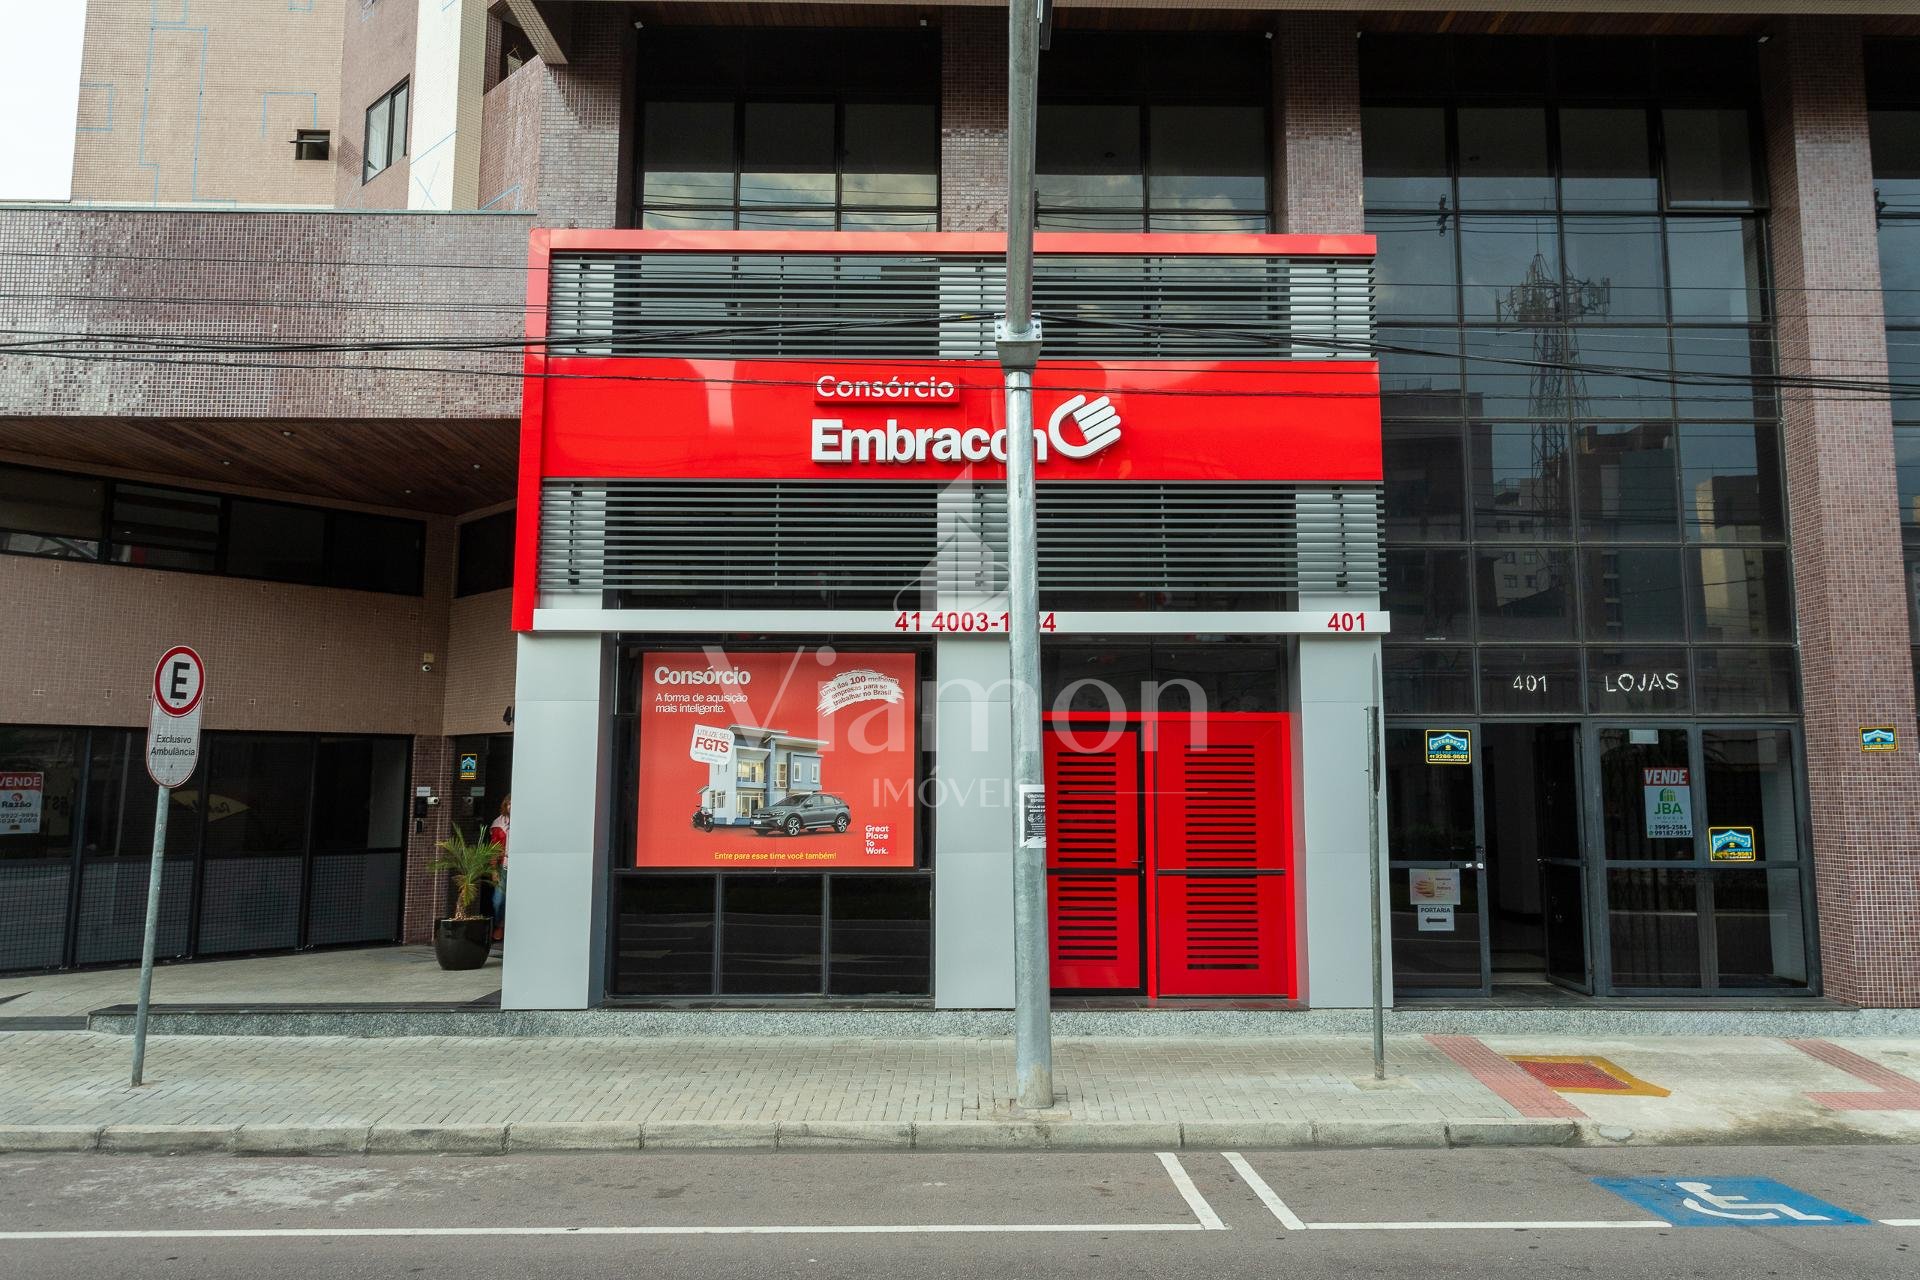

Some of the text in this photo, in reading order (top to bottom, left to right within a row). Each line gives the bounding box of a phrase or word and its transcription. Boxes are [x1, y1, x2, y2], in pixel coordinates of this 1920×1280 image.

[816, 375, 955, 398] Consórcio
[895, 611, 1057, 632] 41 4003-14
[1327, 612, 1365, 631] 401
[170, 661, 190, 699] E
[654, 665, 751, 685] Consórcio
[1605, 673, 1679, 692] LOJAS
[821, 686, 836, 697] Uma
[849, 675, 866, 685] 100
[1513, 675, 1547, 692] 401
[656, 693, 748, 704] A forma de aquisição
[833, 693, 862, 706] trabalhar
[656, 704, 726, 715] mais inteligente.
[156, 734, 191, 744] Exclusivo
[695, 736, 729, 753] FGTS
[150, 746, 195, 756] Ambulância
[1644, 769, 1688, 784] VENDE
[1654, 803, 1683, 815] JBA
[787, 851, 803, 859] você
[805, 851, 837, 860] também!
[866, 847, 889, 855] Work.
